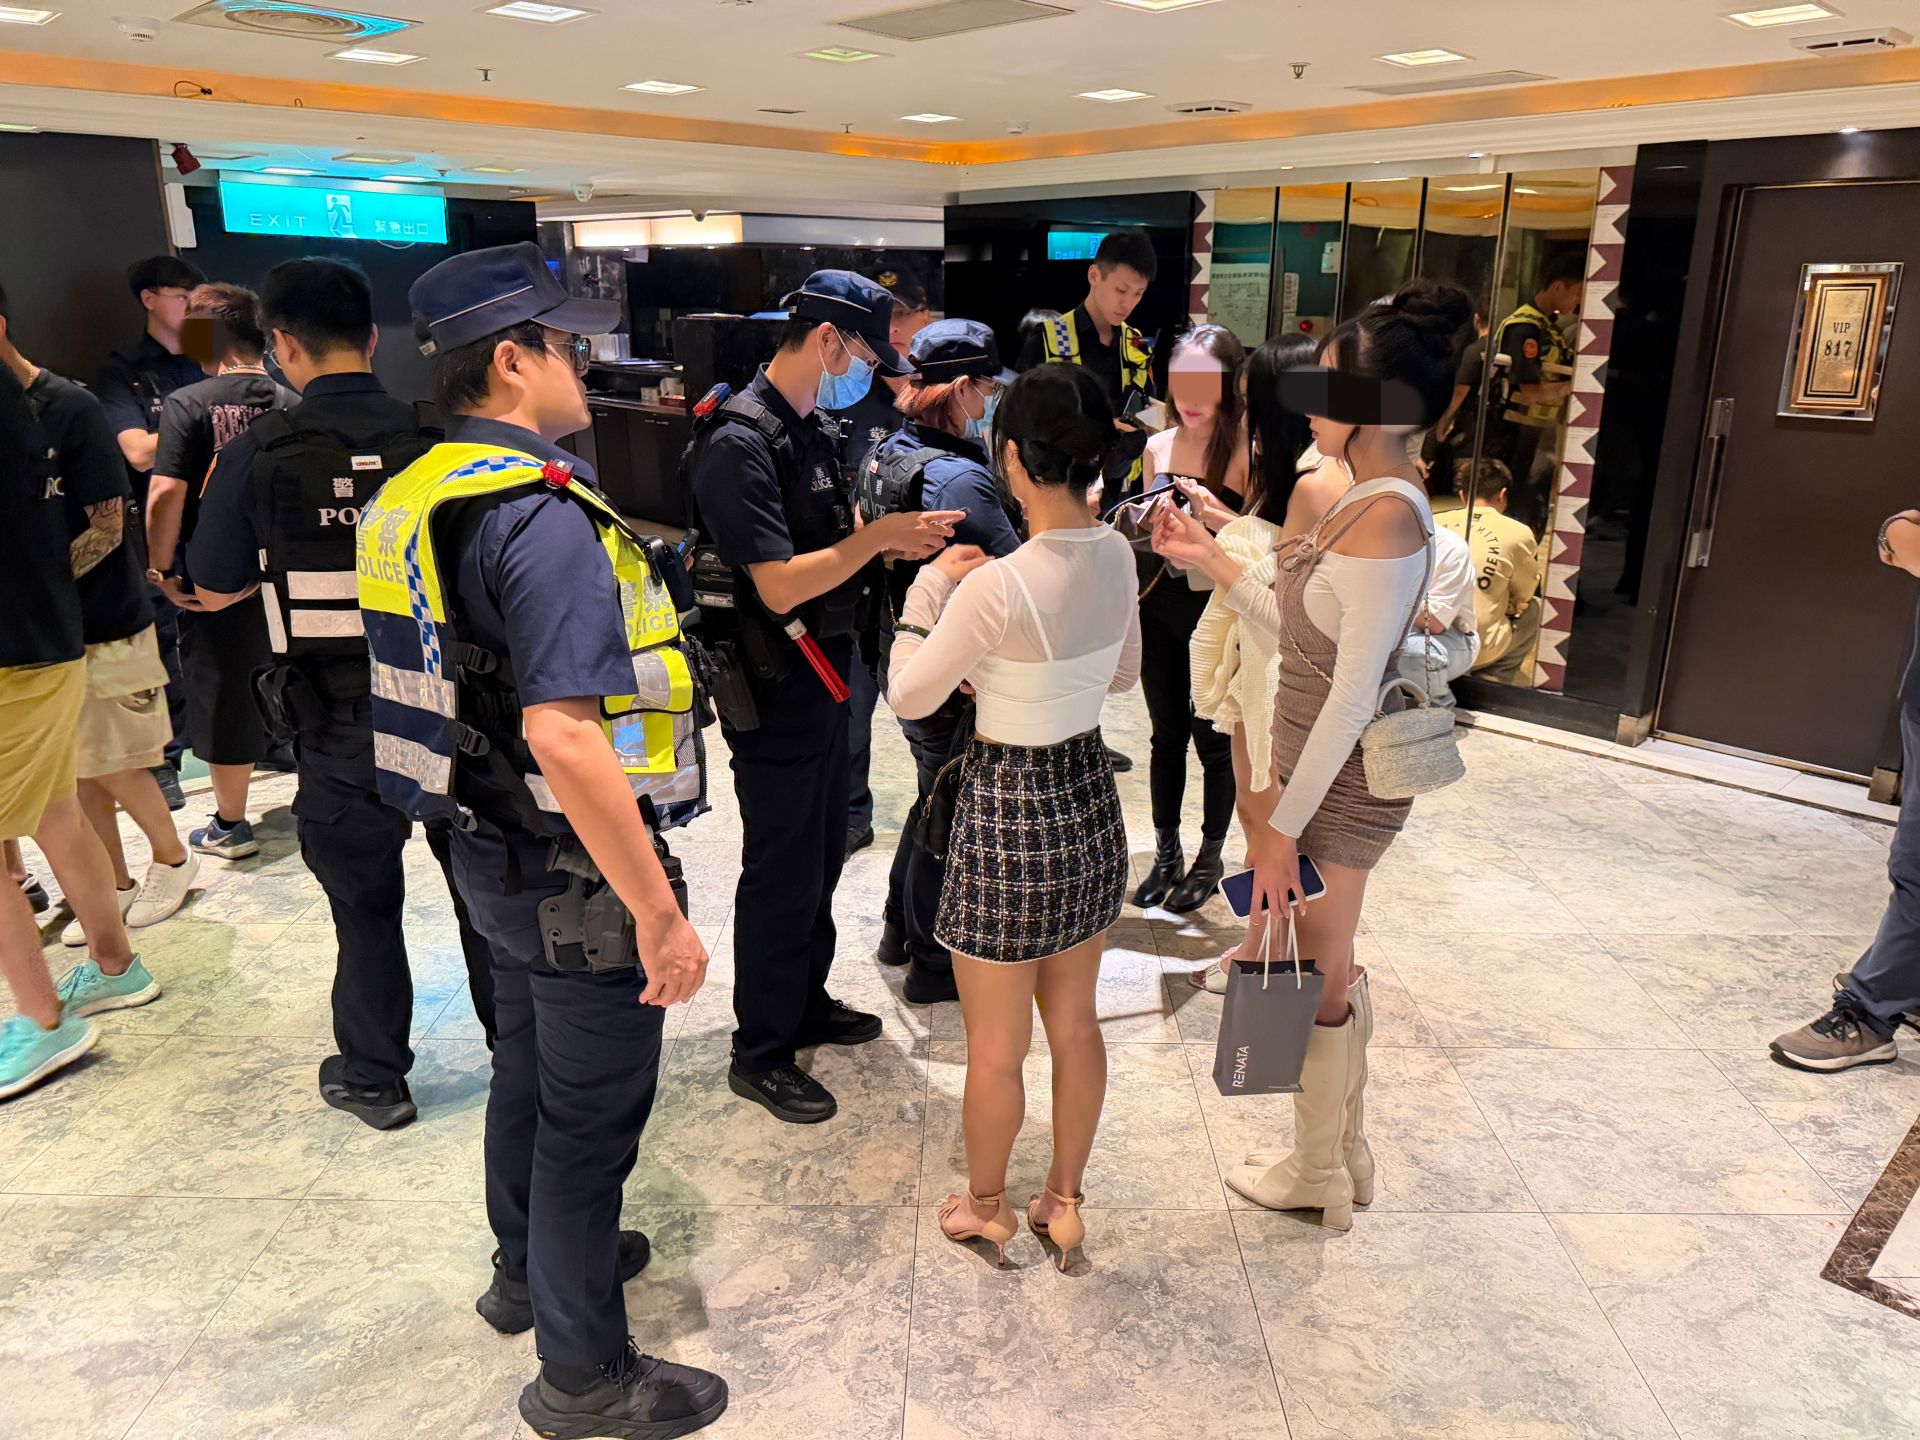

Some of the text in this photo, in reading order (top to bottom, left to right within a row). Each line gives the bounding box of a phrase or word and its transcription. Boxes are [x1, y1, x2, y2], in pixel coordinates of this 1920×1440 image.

[250, 213, 306, 229] EXIT
[374, 219, 429, 235] 緊急出口
[1833, 322, 1851, 334] VIP
[1824, 339, 1853, 357] 817
[810, 477, 835, 491] OLICE
[318, 507, 363, 526] PO
[358, 554, 405, 584] OLICE
[1232, 1045, 1250, 1088] RENATA
